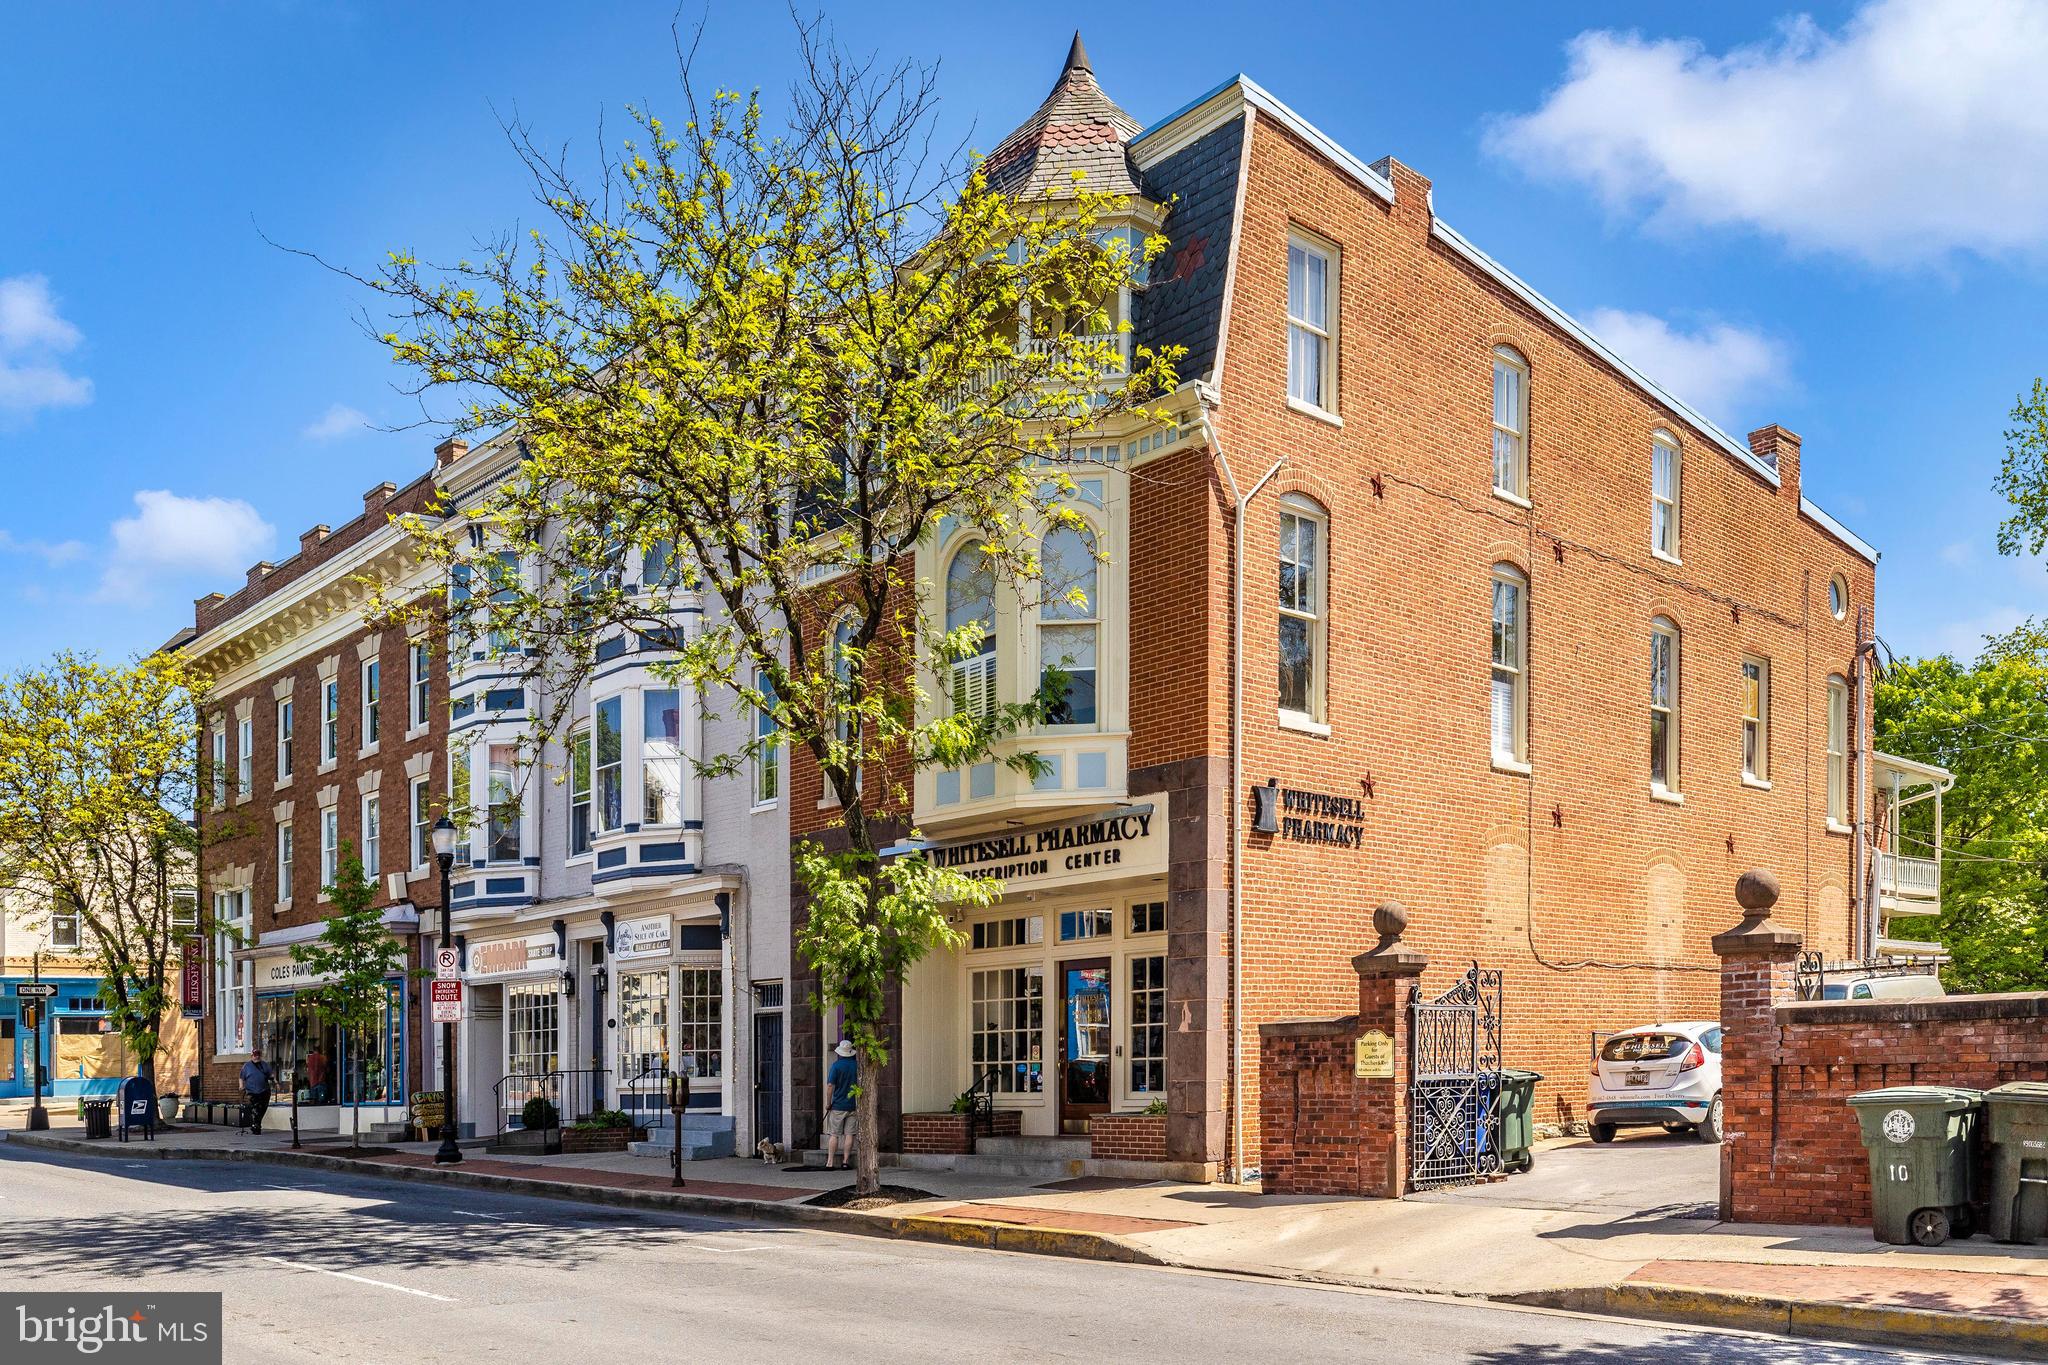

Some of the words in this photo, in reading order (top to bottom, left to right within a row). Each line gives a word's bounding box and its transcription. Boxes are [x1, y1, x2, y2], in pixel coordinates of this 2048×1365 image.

[1282, 788, 1364, 821] WHITESELL
[934, 836, 1031, 868] WHITESELL
[1036, 814, 1151, 852] PHARMACY
[1282, 817, 1364, 846] PHARMACY
[958, 860, 1048, 881] RESCRIPTION
[1065, 849, 1121, 870] CENTER
[190, 971, 199, 1003] FOSTER
[270, 965, 290, 980] COLES
[292, 962, 314, 978] PAWNB
[1889, 1164, 1908, 1181] 10
